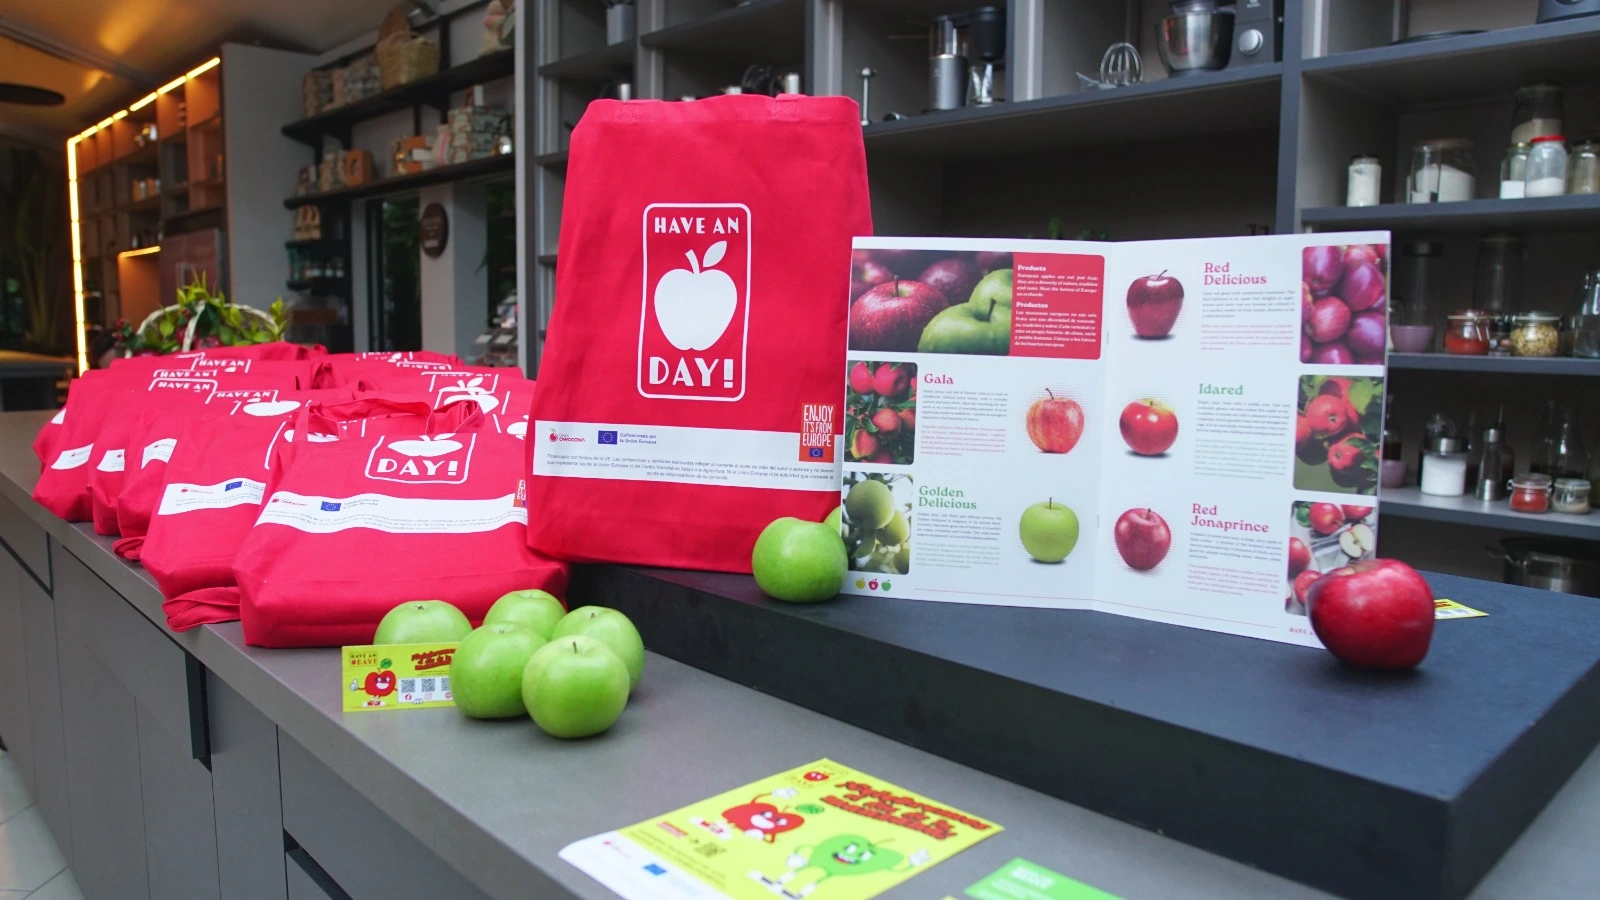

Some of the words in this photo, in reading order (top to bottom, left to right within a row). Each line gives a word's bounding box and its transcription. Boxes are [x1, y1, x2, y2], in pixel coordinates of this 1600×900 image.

[654, 217, 705, 234] HAVE
[713, 217, 739, 234] AN
[1204, 262, 1230, 273] Red
[1203, 274, 1267, 285] Delicious
[649, 356, 734, 389] DAY!
[924, 373, 954, 385] Gala
[158, 381, 191, 389] HAVE
[1199, 383, 1244, 395] Idared
[803, 405, 834, 422] ENJOY
[803, 421, 815, 433] IT'S
[816, 422, 832, 434] FROM
[802, 433, 832, 447] EUROPE
[376, 458, 458, 476] DAY!
[919, 485, 964, 497] Golden
[918, 496, 977, 510] Delicious
[1192, 503, 1218, 516] Red
[1190, 515, 1269, 533] Jonaprince
